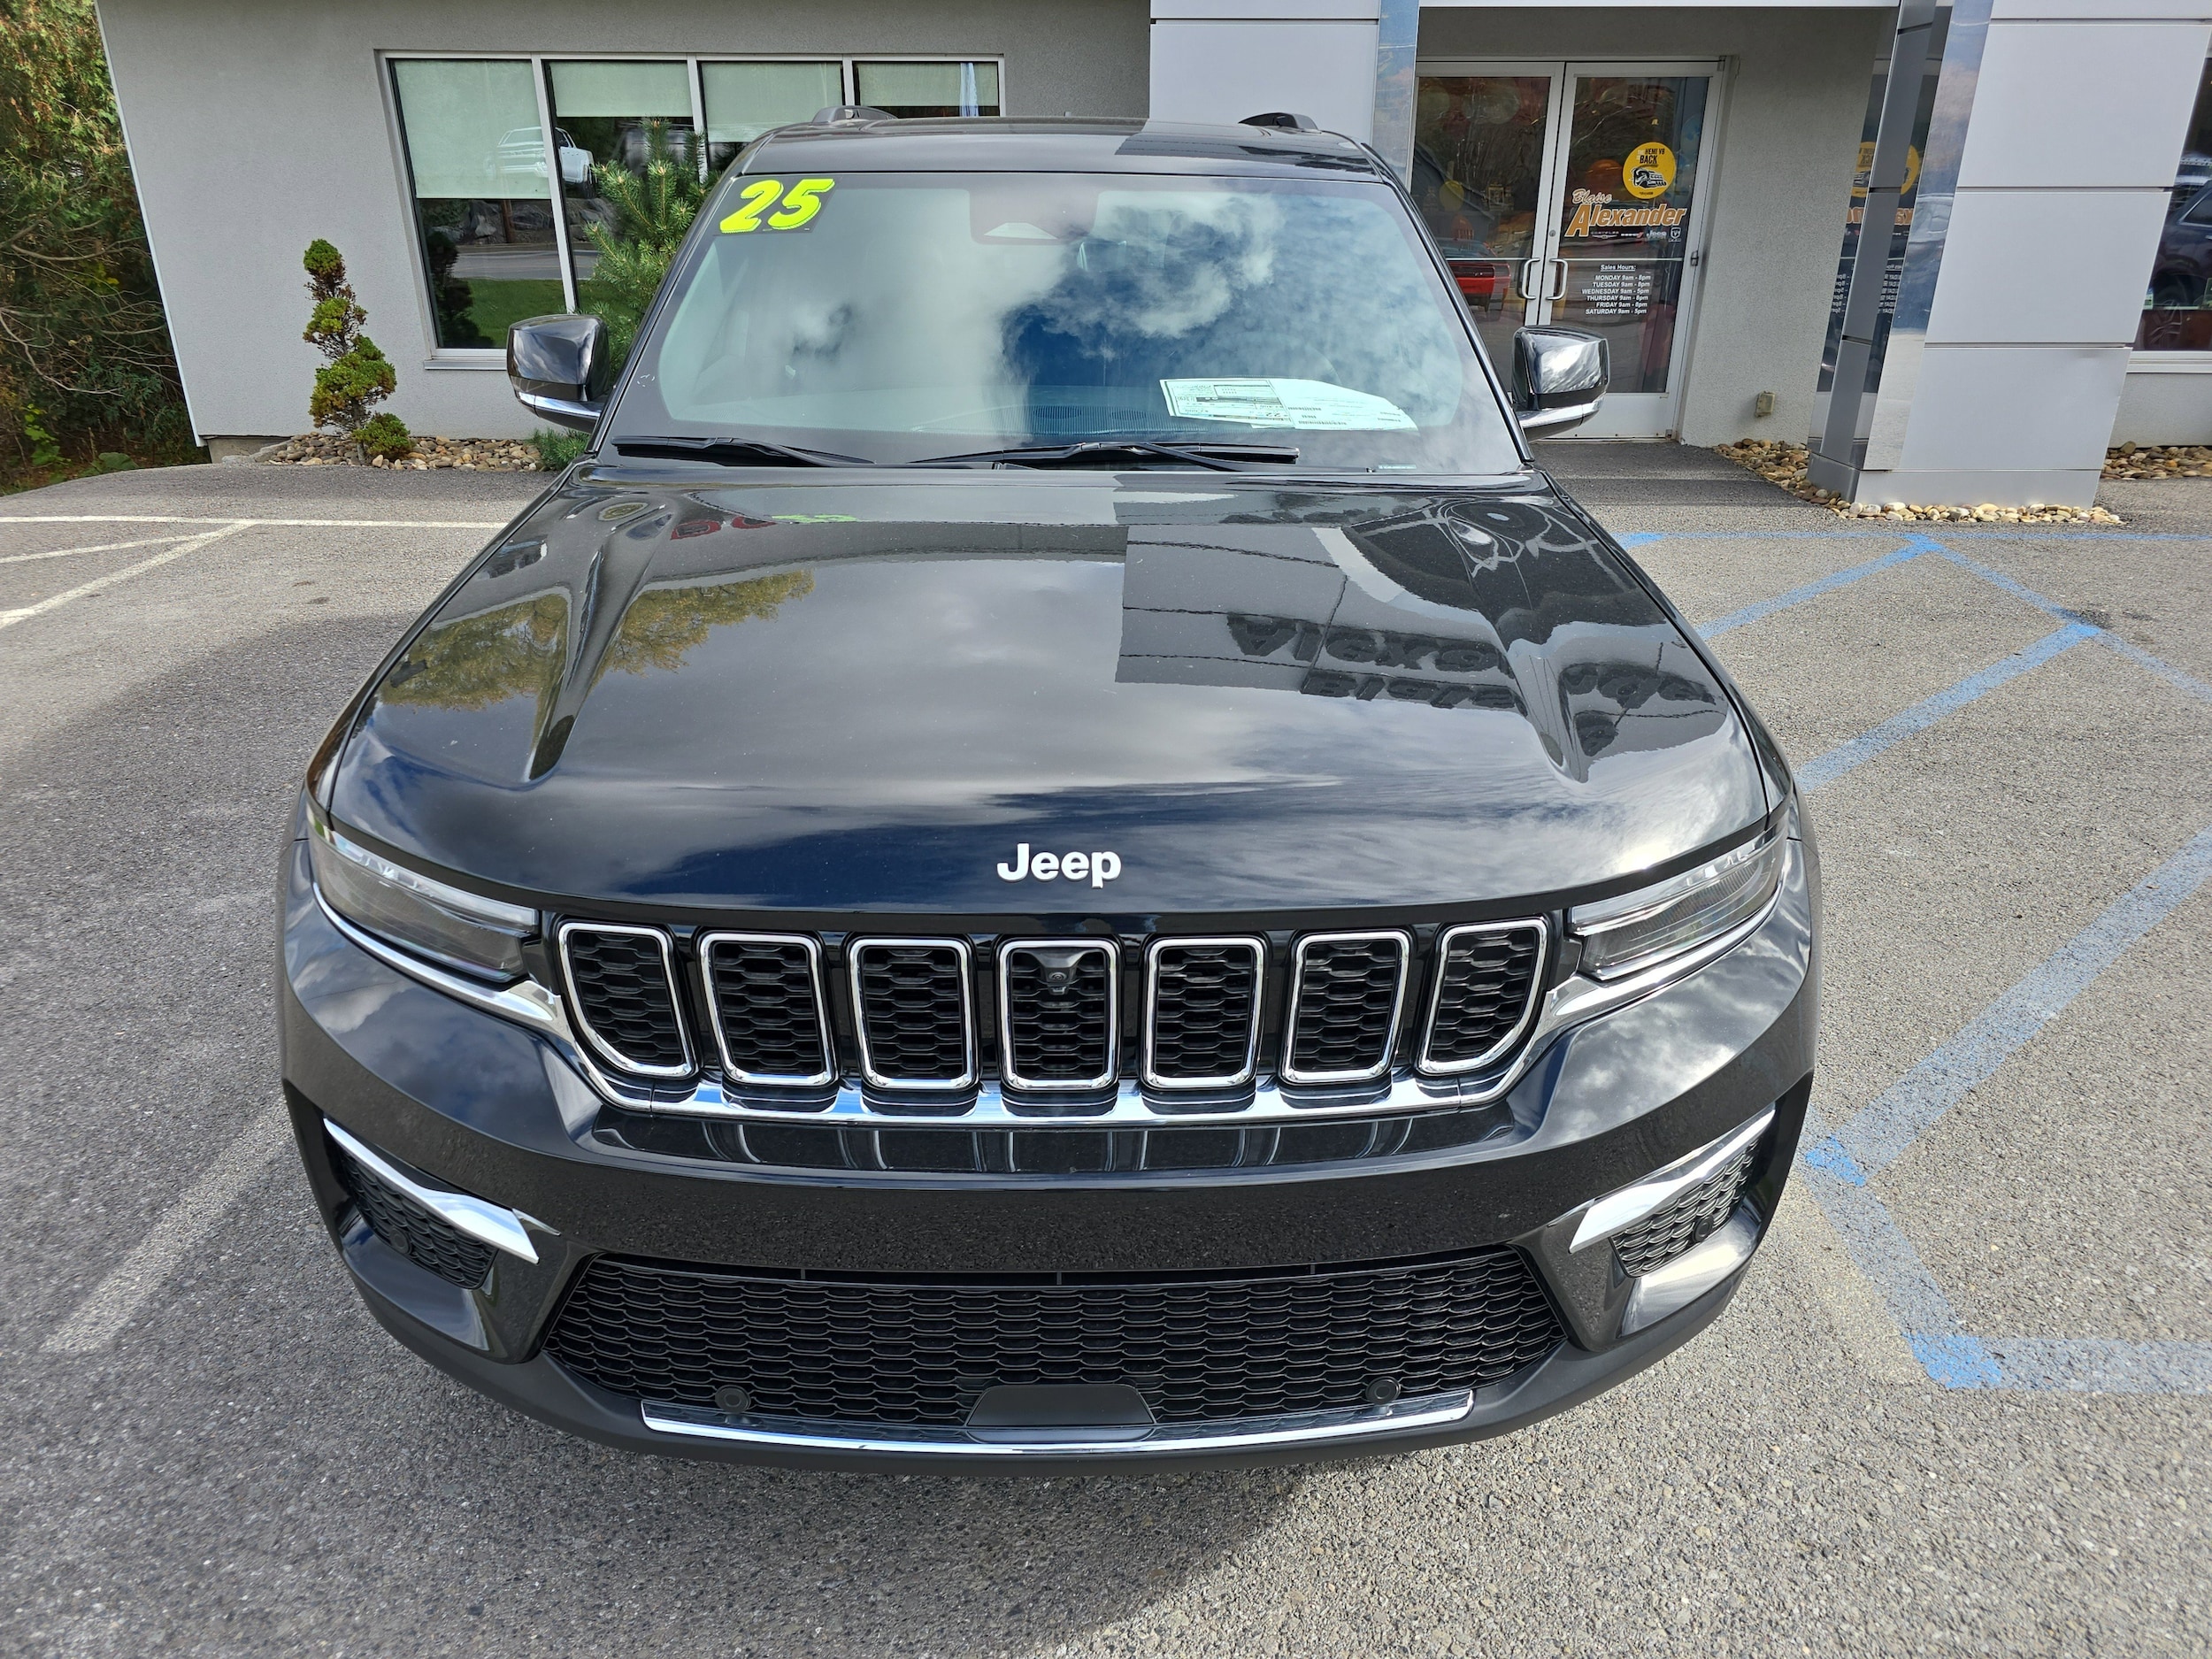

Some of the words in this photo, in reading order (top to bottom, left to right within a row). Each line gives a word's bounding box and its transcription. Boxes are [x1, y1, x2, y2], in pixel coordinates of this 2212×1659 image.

[1640, 155, 1658, 164] BACK
[719, 179, 835, 234] 25
[1571, 188, 1612, 204] Blaise
[1563, 203, 1687, 237] Alexander
[996, 842, 1122, 889] Jeep
